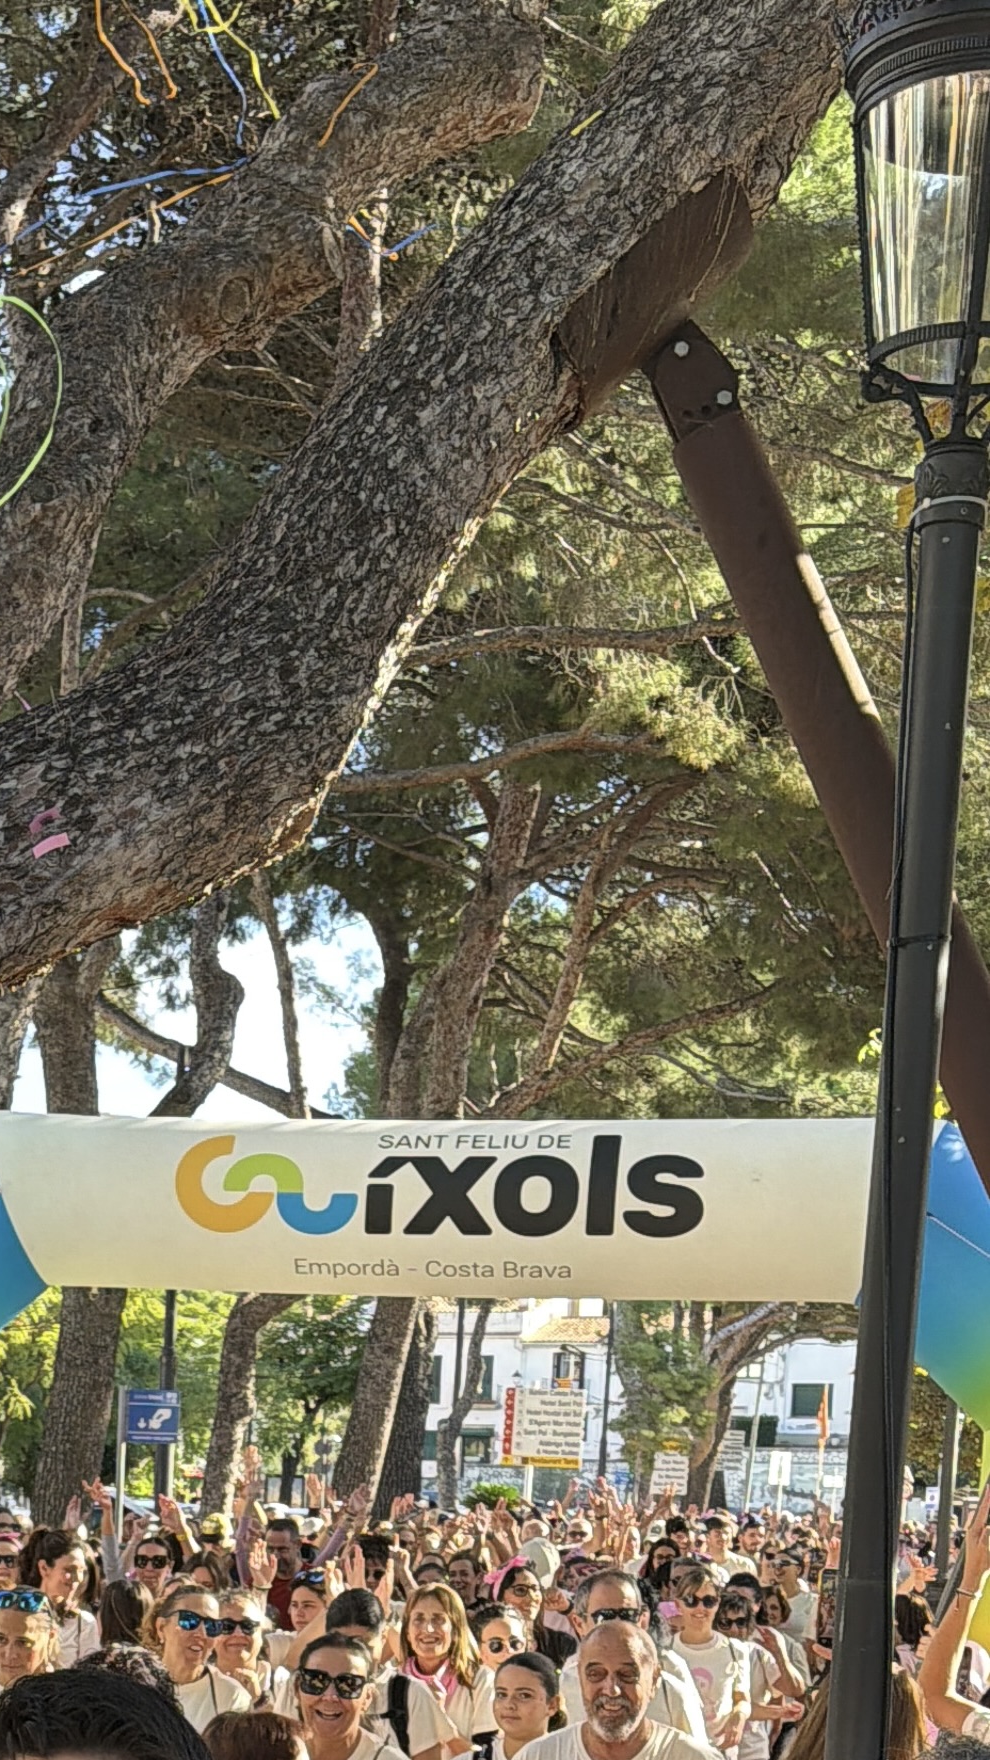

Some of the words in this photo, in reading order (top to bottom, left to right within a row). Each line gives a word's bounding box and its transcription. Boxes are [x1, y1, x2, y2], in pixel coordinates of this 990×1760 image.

[378, 1134, 449, 1149] SANT
[455, 1134, 529, 1149] FELIU
[537, 1134, 573, 1149] DE
[294, 1258, 400, 1279] Empordà
[425, 1260, 495, 1278] Costa
[502, 1261, 572, 1279] Brava
